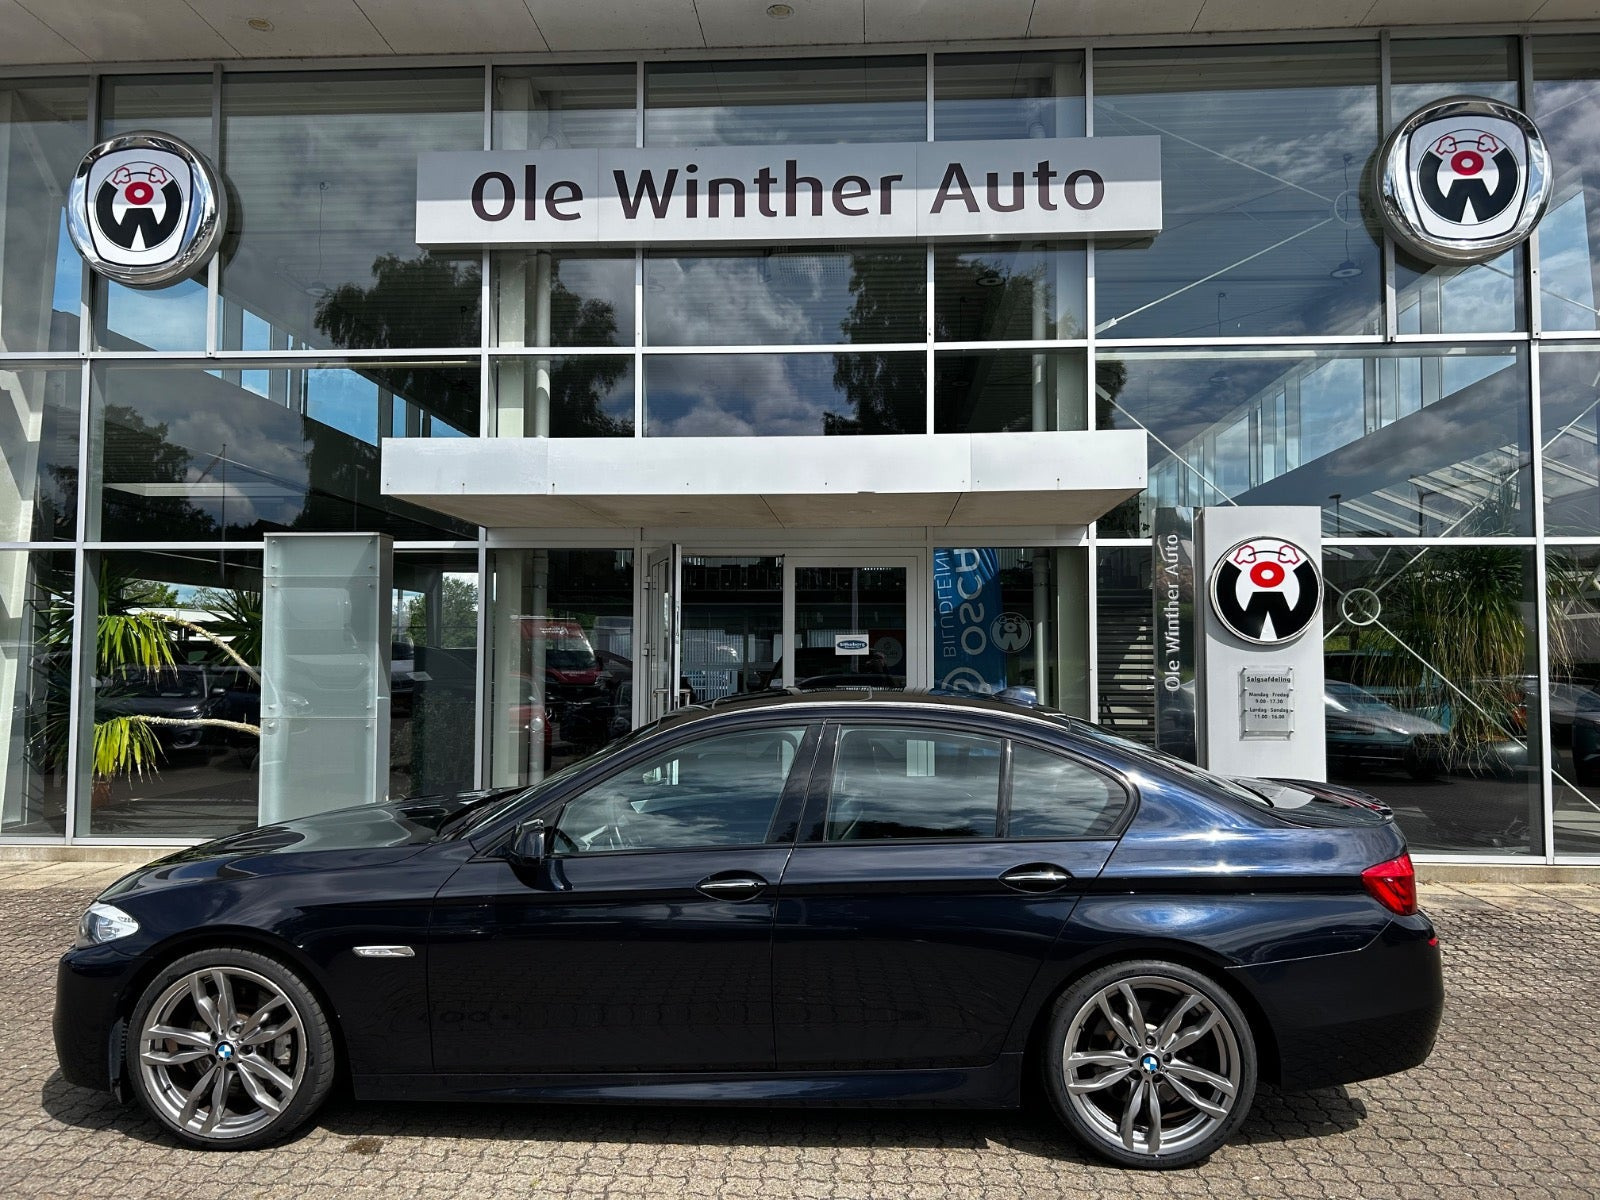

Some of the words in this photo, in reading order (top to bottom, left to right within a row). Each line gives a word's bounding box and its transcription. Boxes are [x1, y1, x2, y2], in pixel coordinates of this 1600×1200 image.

[472, 165, 583, 221] Ole
[613, 160, 903, 219] Winther
[930, 160, 1104, 213] Auto
[1165, 534, 1179, 576] Auto
[1164, 582, 1180, 655] Winther
[1164, 660, 1181, 692] Ole
